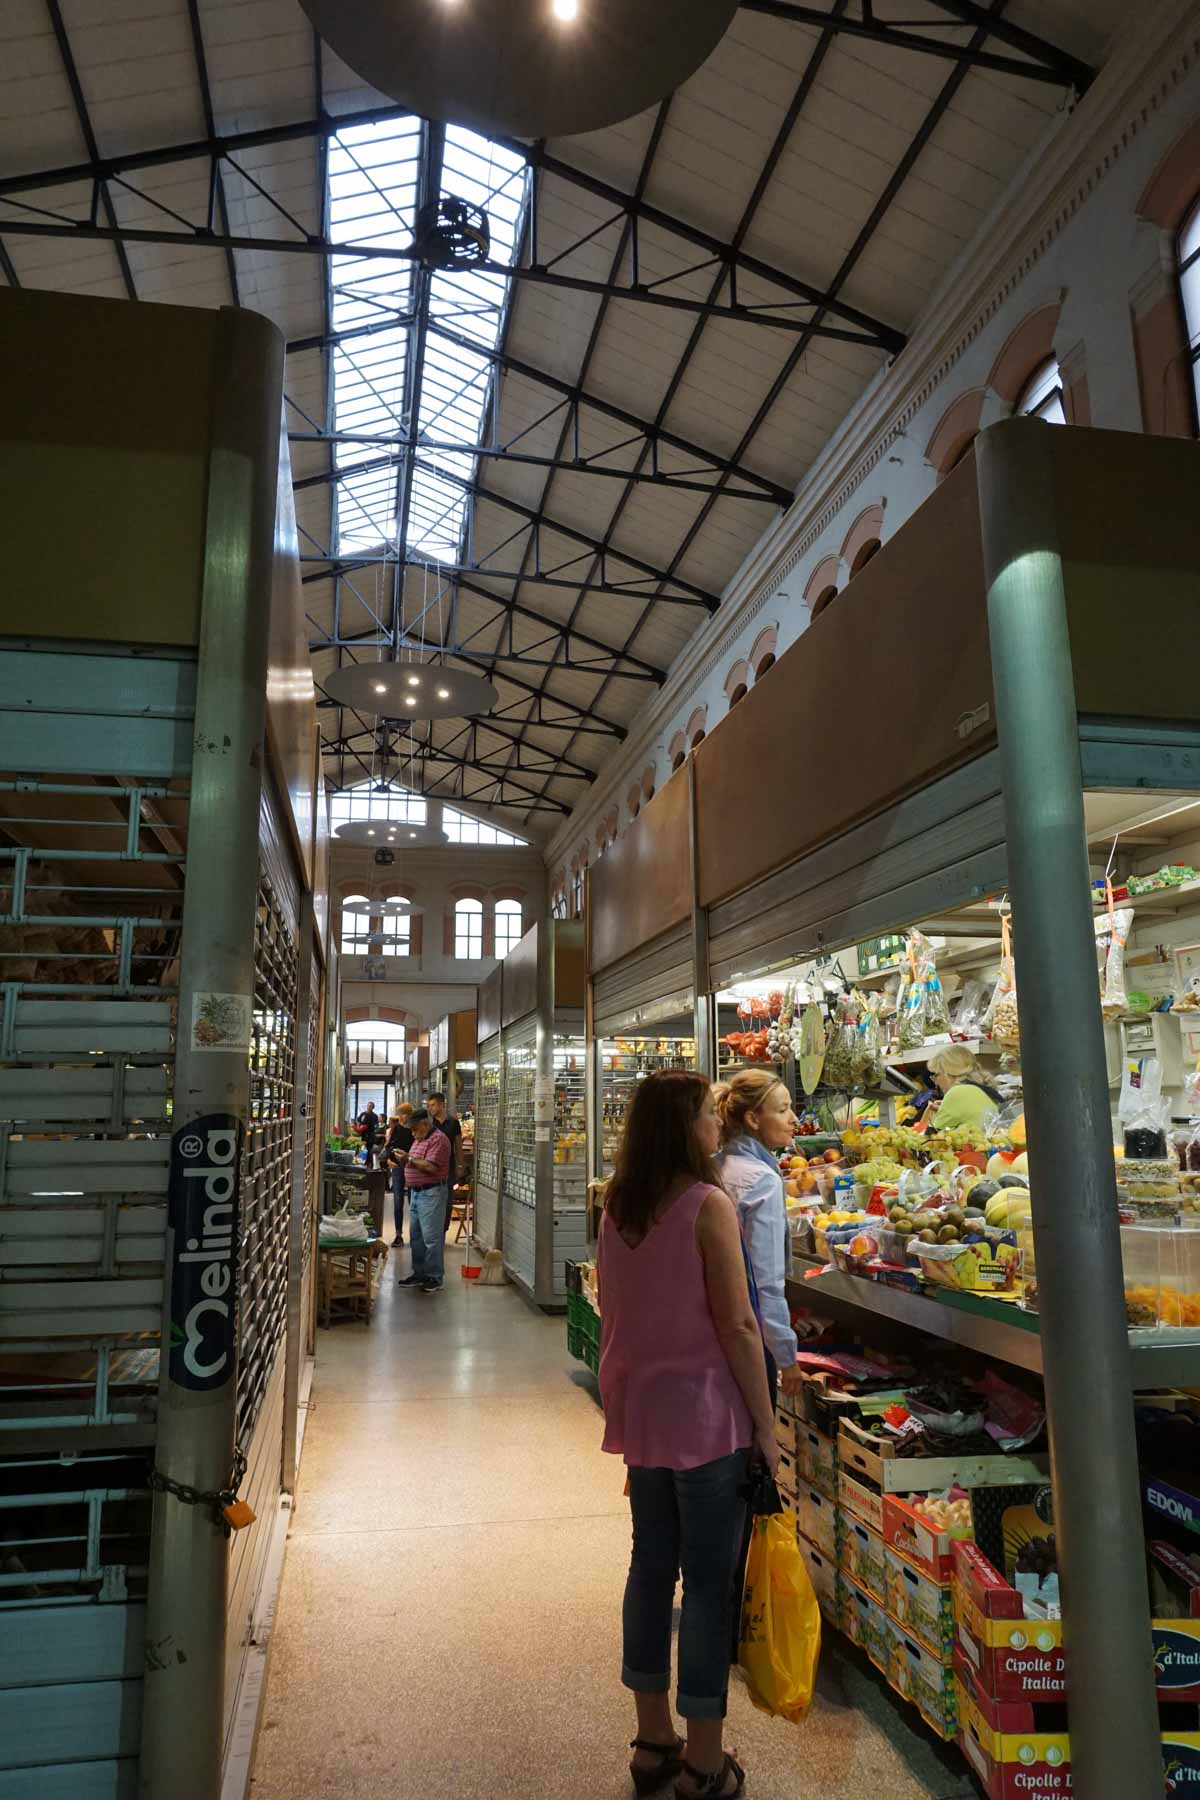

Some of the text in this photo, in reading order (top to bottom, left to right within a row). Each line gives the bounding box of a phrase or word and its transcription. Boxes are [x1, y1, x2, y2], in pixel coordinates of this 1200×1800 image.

[180, 1129, 236, 1378] Melinda
[1005, 1657, 1051, 1674] Cipolle
[1014, 1773, 1061, 1790] Cipolle
